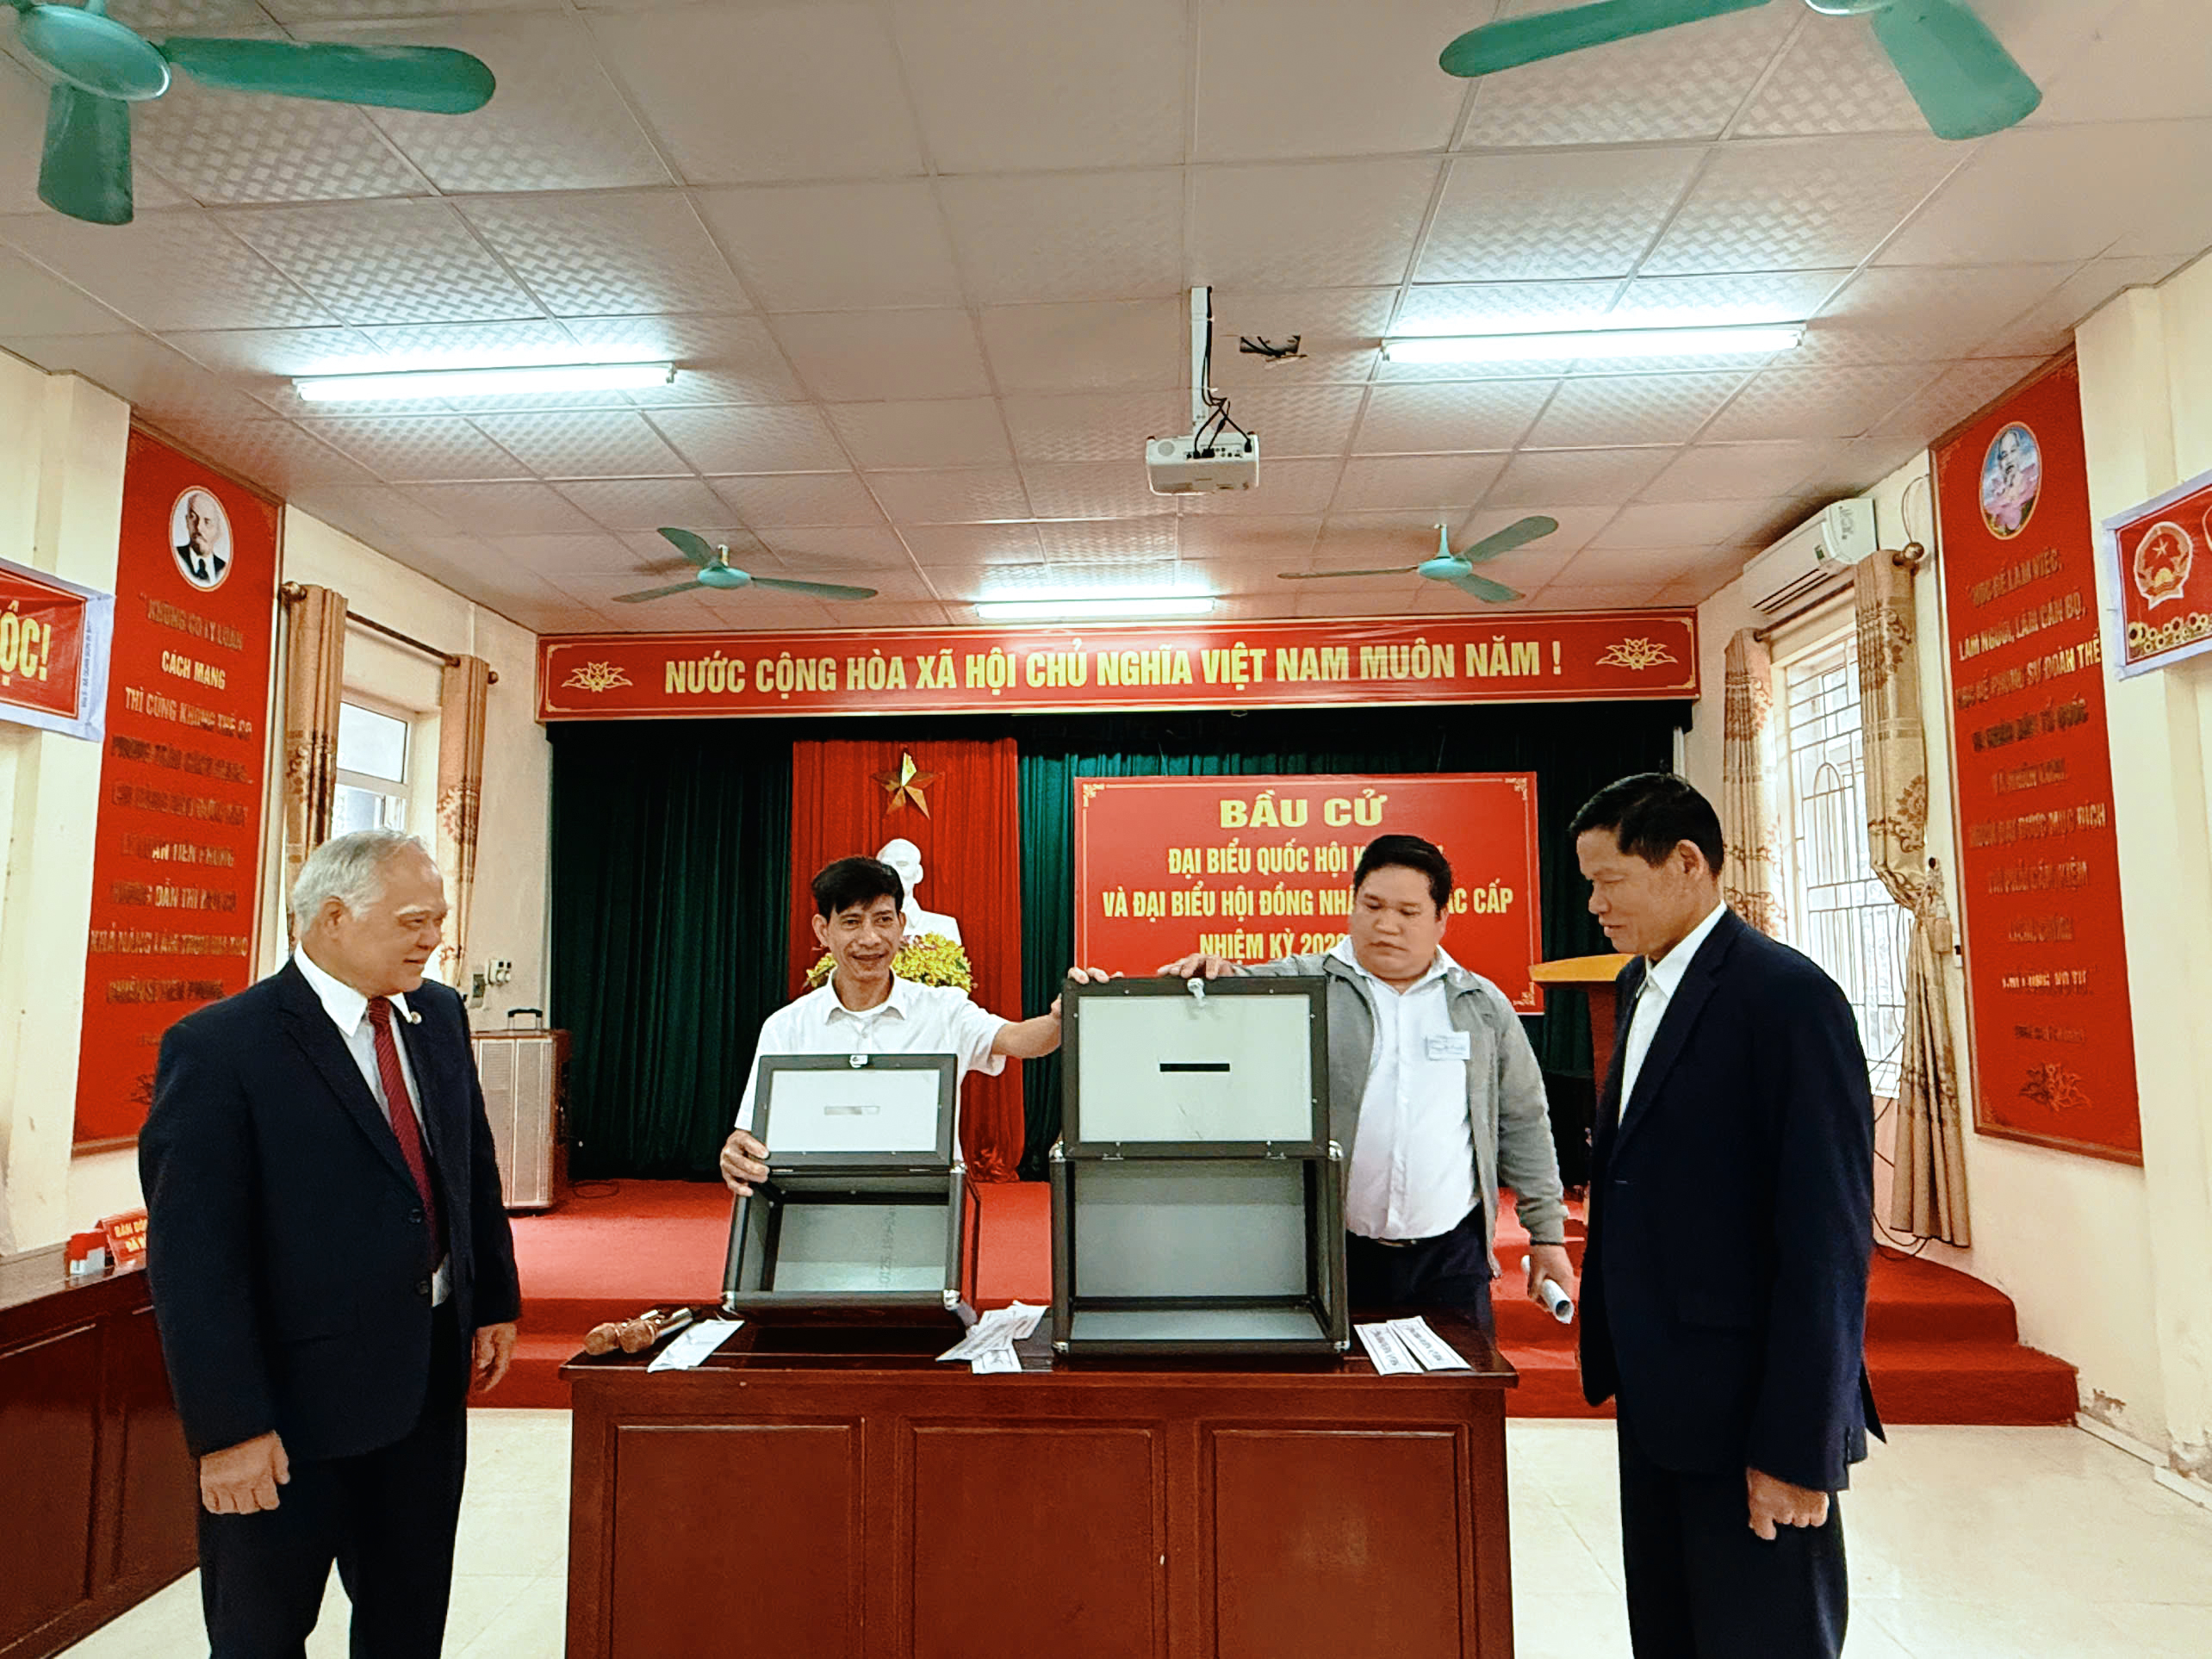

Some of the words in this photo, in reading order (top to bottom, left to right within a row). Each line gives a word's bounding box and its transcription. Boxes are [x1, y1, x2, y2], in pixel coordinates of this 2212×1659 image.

[0, 600, 52, 687] ỘC!
[666, 651, 746, 694] NƯỚC
[756, 651, 836, 699] CỘNG
[847, 648, 907, 691] HÒA
[916, 648, 957, 688] XÃ
[965, 646, 1017, 696] HỘI
[1026, 637, 1088, 687] CHỦ
[1097, 643, 1193, 687] NGHĨA
[1201, 641, 1267, 691] VIỆT
[1276, 647, 1348, 682] NAM
[1359, 637, 1455, 680] MUÔN
[1464, 636, 1540, 678] NĂM
[1220, 790, 1308, 829] BẦU
[1324, 788, 1388, 828] CỬ
[1168, 848, 1202, 879] ĐẠI
[1207, 837, 1252, 874] BIỂU
[1257, 841, 1309, 876] QUỐC
[1314, 841, 1348, 878] HỘI
[1103, 885, 1129, 917] VÀ
[1133, 891, 1166, 923] ĐẠI
[1171, 880, 1215, 917] BIỂU
[1221, 887, 1254, 923] HỘI
[1258, 881, 1314, 916] ĐỒNG
[1319, 884, 1355, 916] NHÂ
[1473, 878, 1513, 914] CẤP
[1199, 928, 1264, 966] NHIỆM
[1270, 927, 1296, 958] KỲ
[1300, 932, 1345, 955] 202
